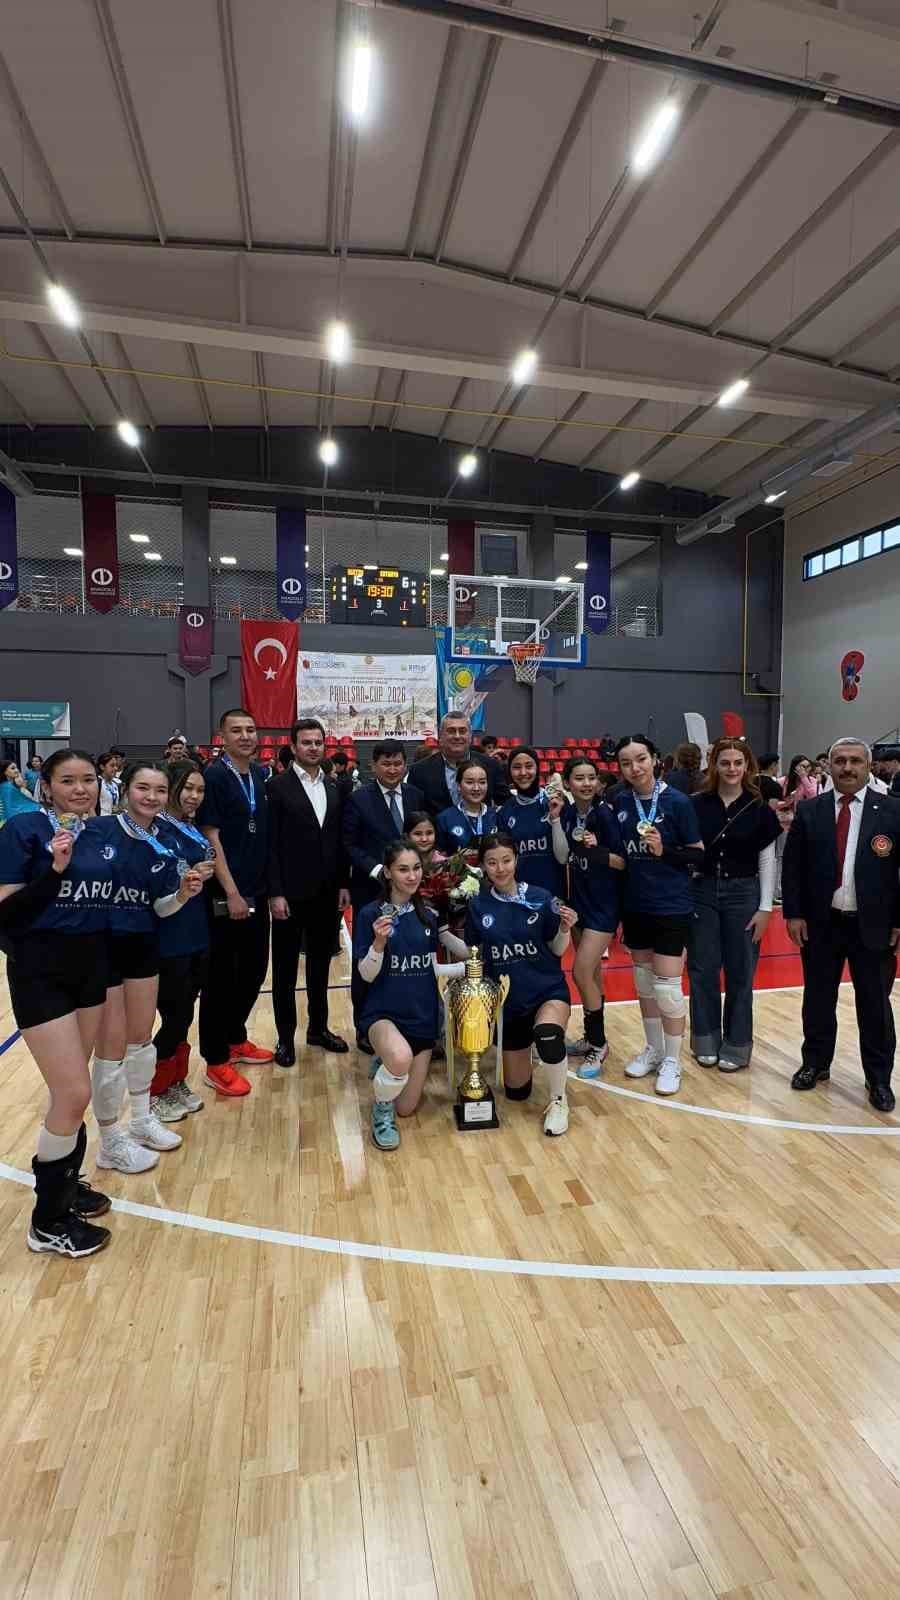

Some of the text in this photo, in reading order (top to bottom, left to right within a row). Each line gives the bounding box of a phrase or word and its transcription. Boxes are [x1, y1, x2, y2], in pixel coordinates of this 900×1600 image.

[402, 577, 409, 588] 6
[367, 584, 393, 598] 19:30
[387, 687, 406, 703] 2026
